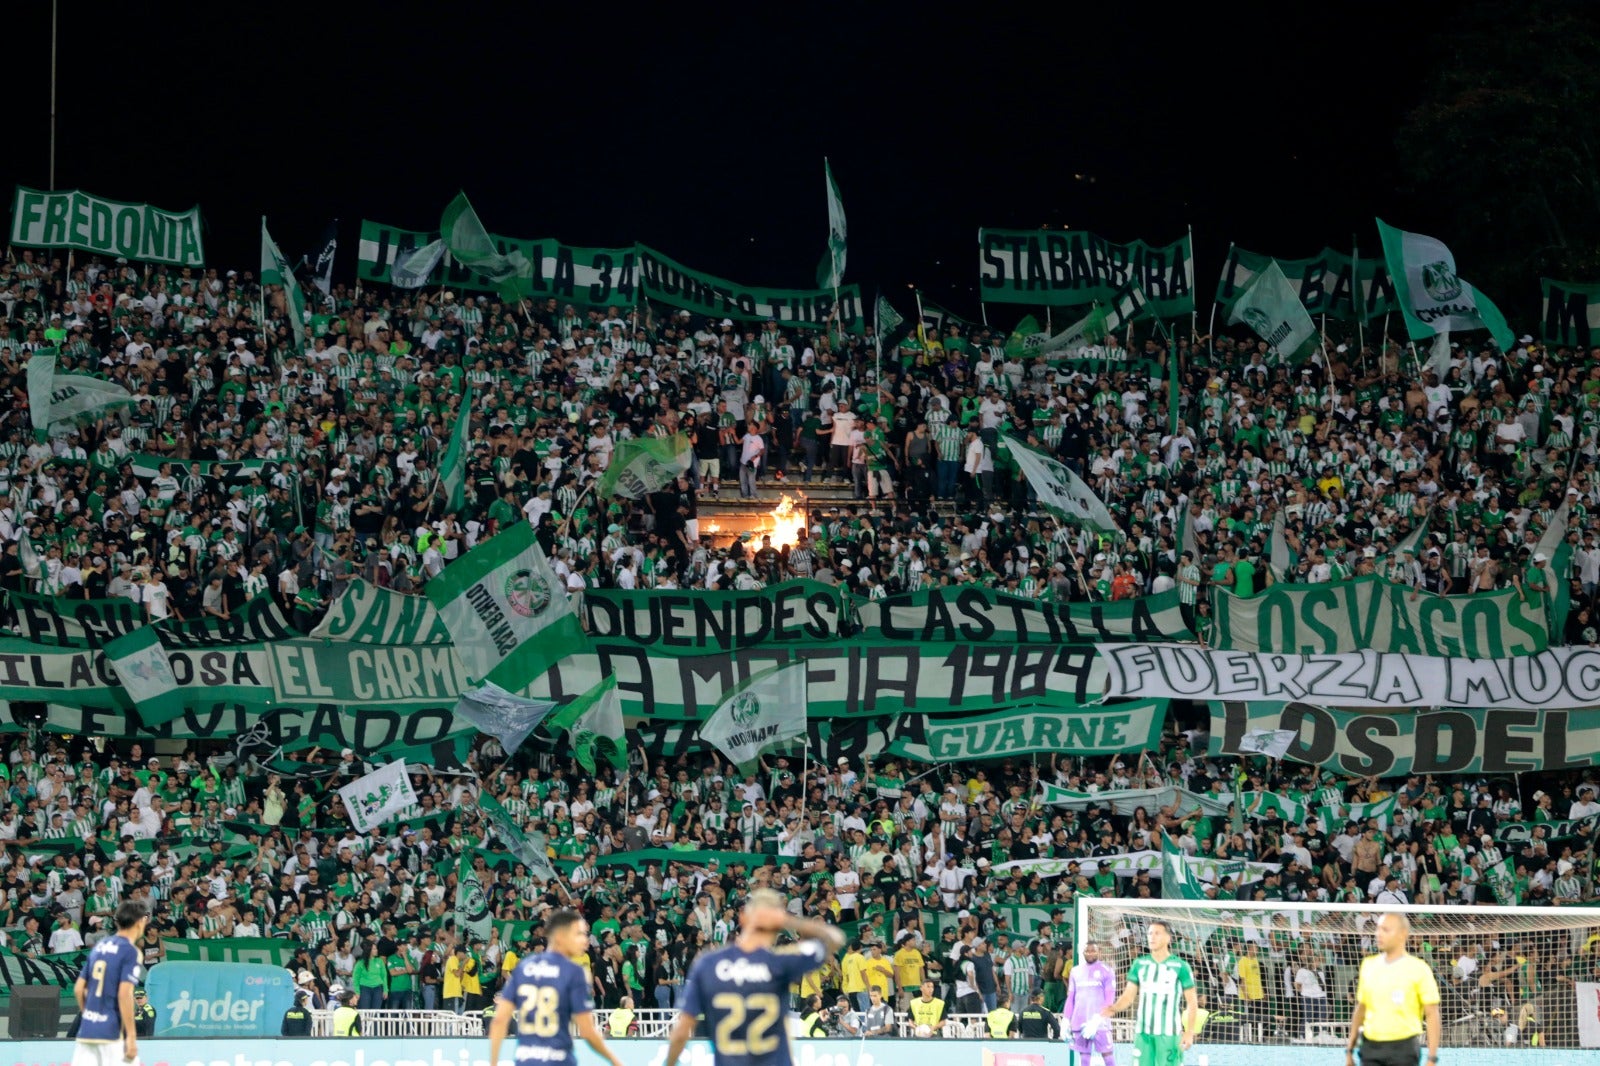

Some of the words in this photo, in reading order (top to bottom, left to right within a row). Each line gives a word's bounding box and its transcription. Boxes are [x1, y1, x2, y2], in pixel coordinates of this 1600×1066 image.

[19, 192, 200, 261] FREDONIA
[533, 244, 575, 298] LA
[590, 252, 634, 303] 34
[587, 587, 838, 648] DUENDES
[880, 588, 1166, 643] CASTILLA
[277, 644, 334, 697] EL
[678, 644, 920, 716] MAFIA
[942, 644, 1096, 706] 1989
[1110, 646, 1422, 704] FUERZA
[937, 715, 1131, 757] GUARNE
[92, 959, 107, 998] 9
[166, 990, 265, 1025] inder
[516, 983, 560, 1038] 28
[711, 992, 781, 1056] 22
